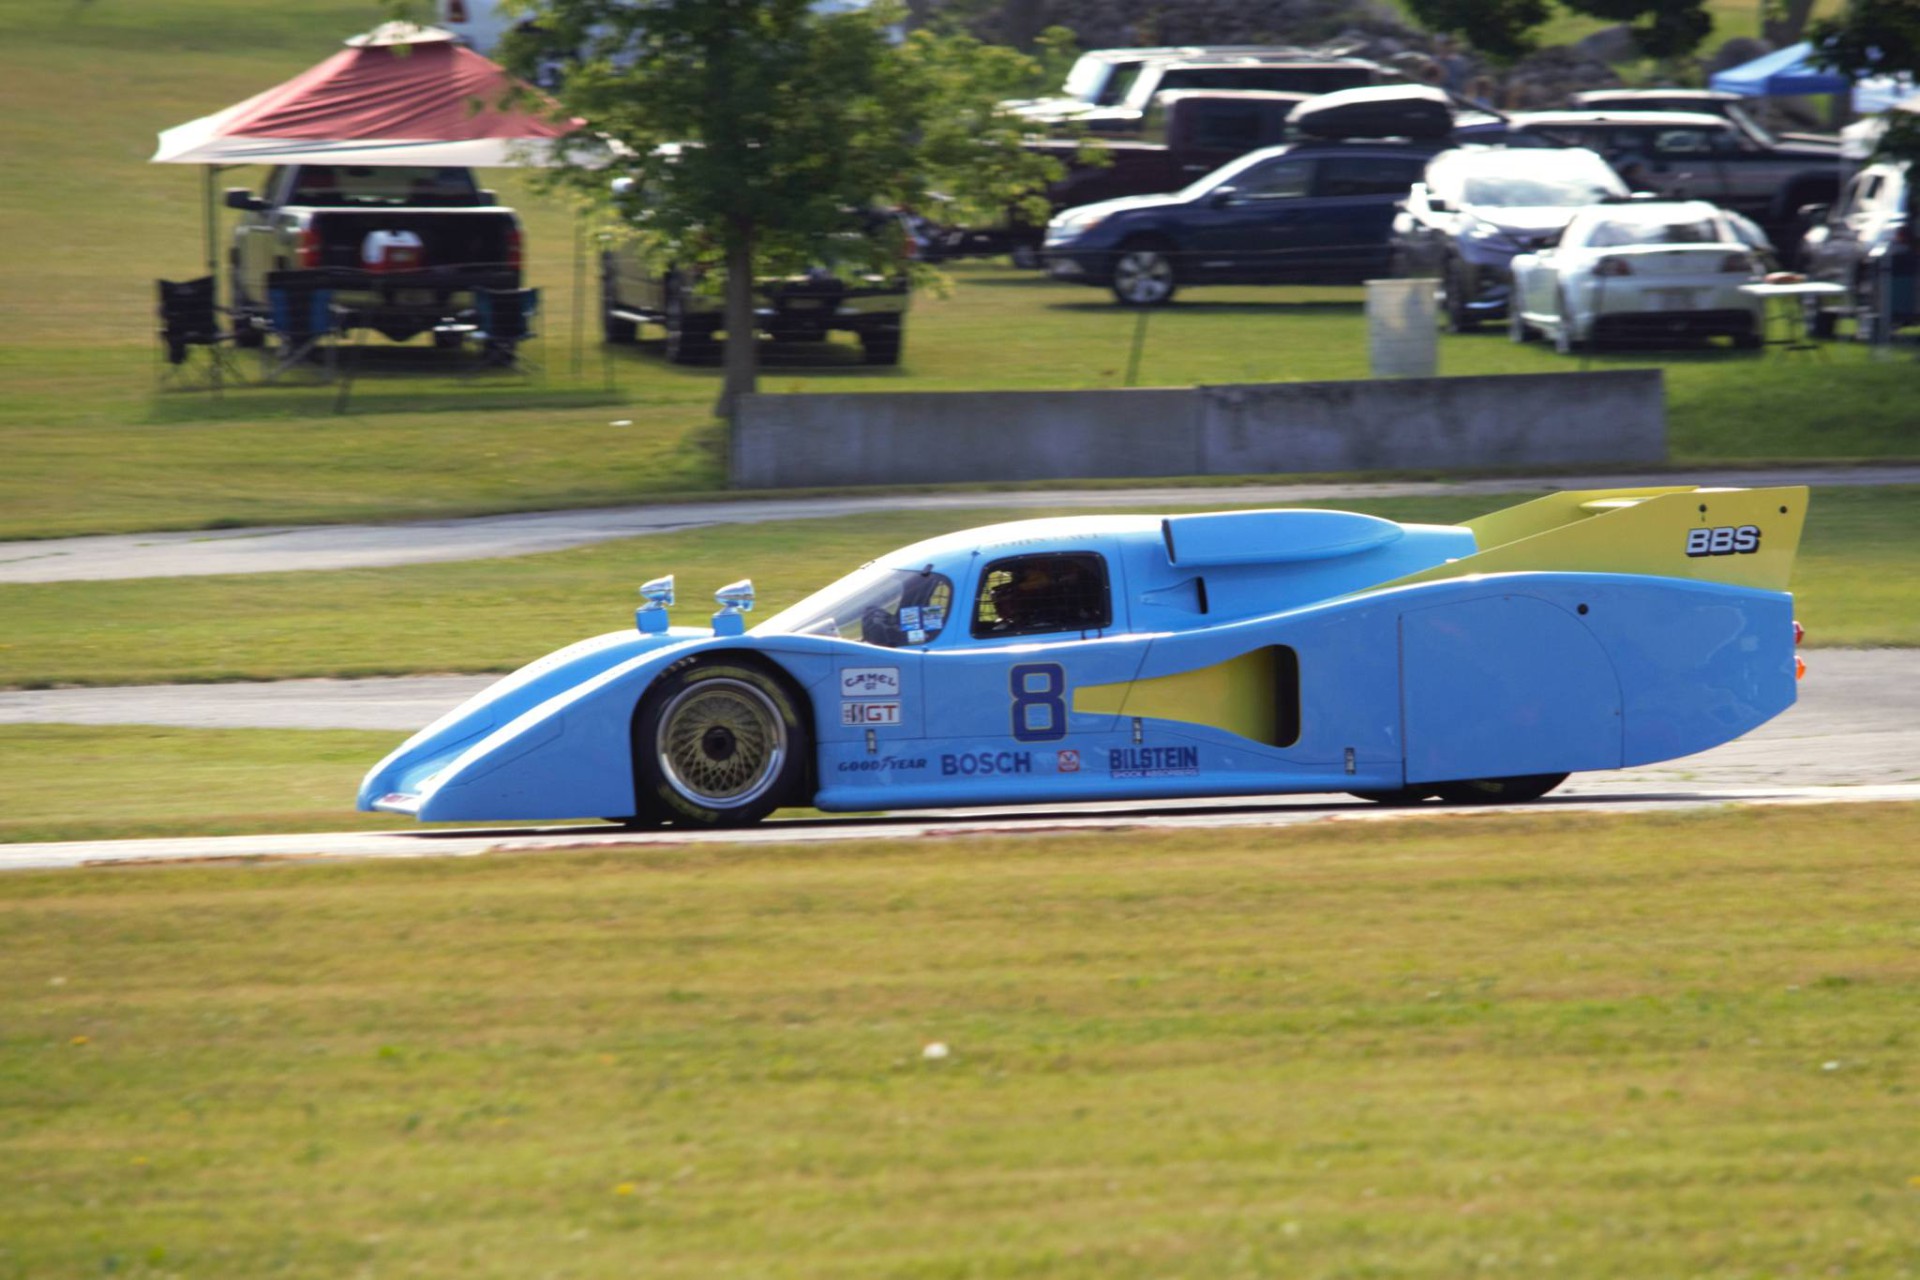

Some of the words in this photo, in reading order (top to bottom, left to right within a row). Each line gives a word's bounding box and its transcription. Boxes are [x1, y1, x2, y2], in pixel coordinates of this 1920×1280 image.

[1686, 525, 1762, 557] BBS
[844, 673, 897, 688] CAMEL
[866, 704, 898, 721] GT
[1009, 662, 1067, 742] 8
[838, 756, 927, 772] GOODYEAR
[941, 751, 1032, 776] BOSCH
[1109, 746, 1199, 770] BILSTEIN
